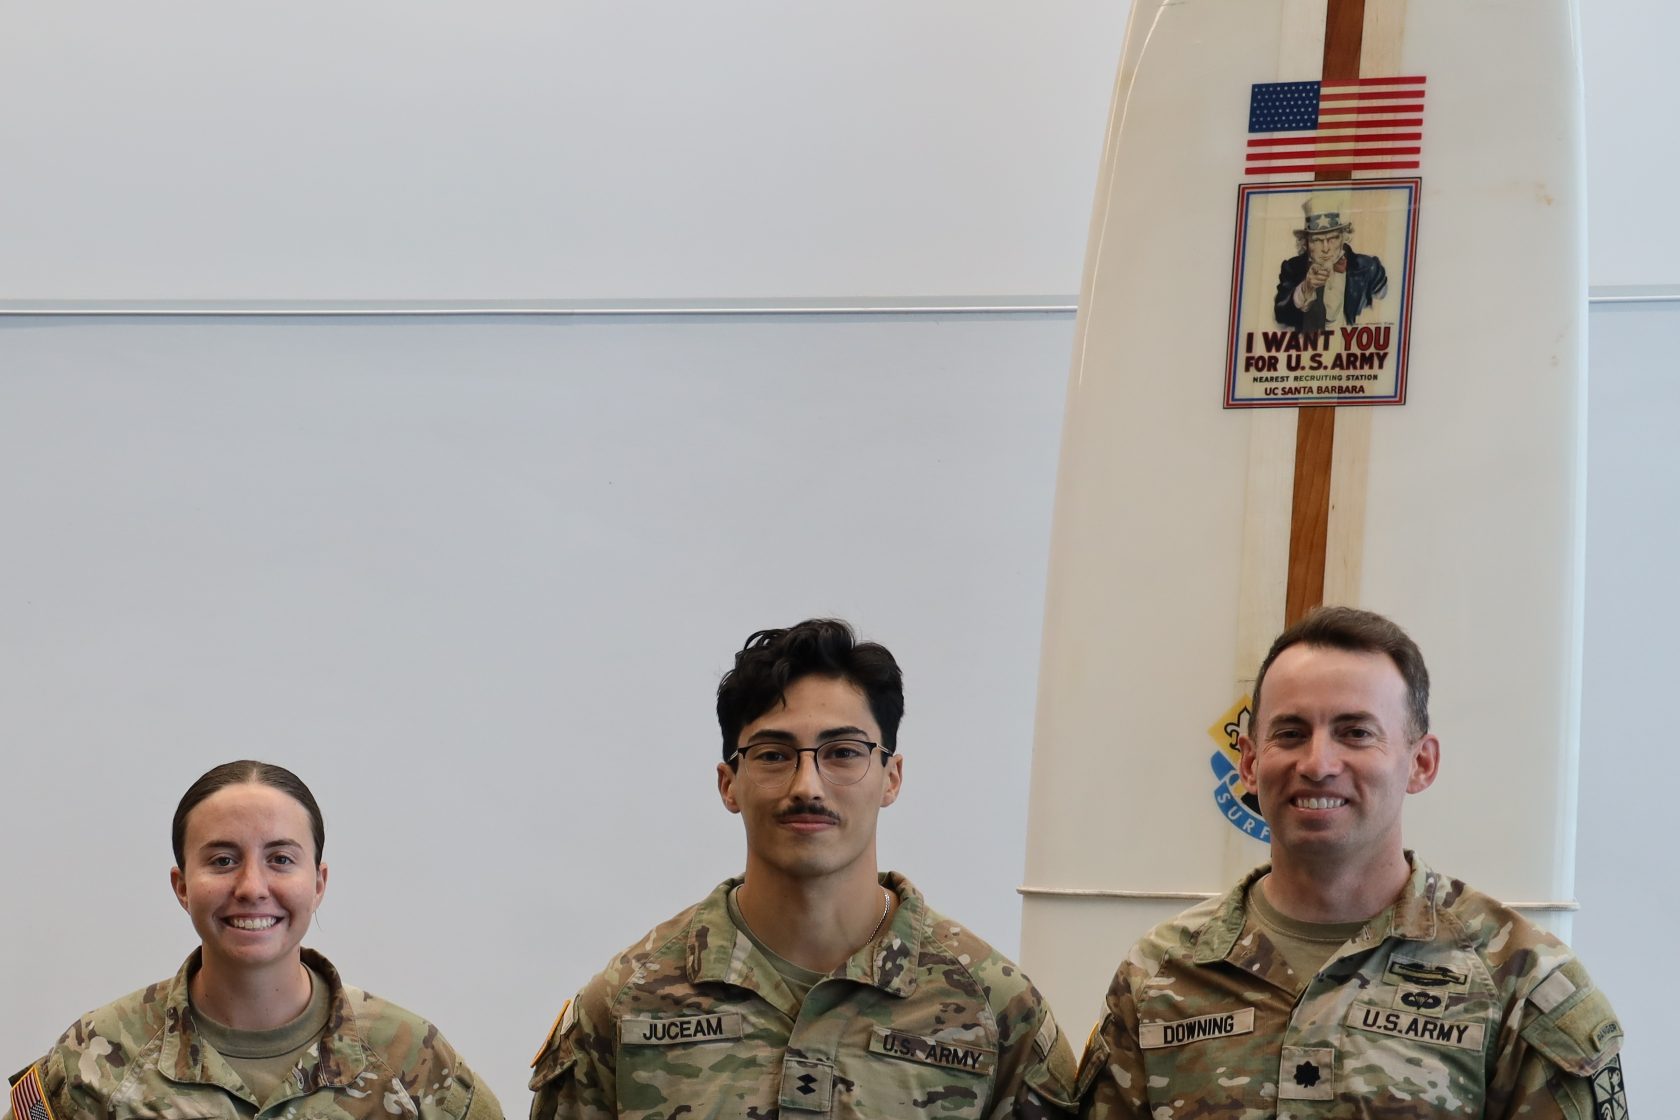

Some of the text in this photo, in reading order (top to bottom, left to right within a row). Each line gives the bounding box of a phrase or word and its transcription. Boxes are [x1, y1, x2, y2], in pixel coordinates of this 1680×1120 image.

[1246, 326, 1391, 354] I WANT YOU
[1244, 355, 1279, 372] FOR
[1264, 384, 1365, 396] UC SANTA BARBARA
[1217, 792, 1270, 838] SURF
[642, 1016, 723, 1041] JUCEAM
[1163, 1015, 1234, 1044] DOWNING
[882, 1034, 983, 1070] U.S. ARMY
